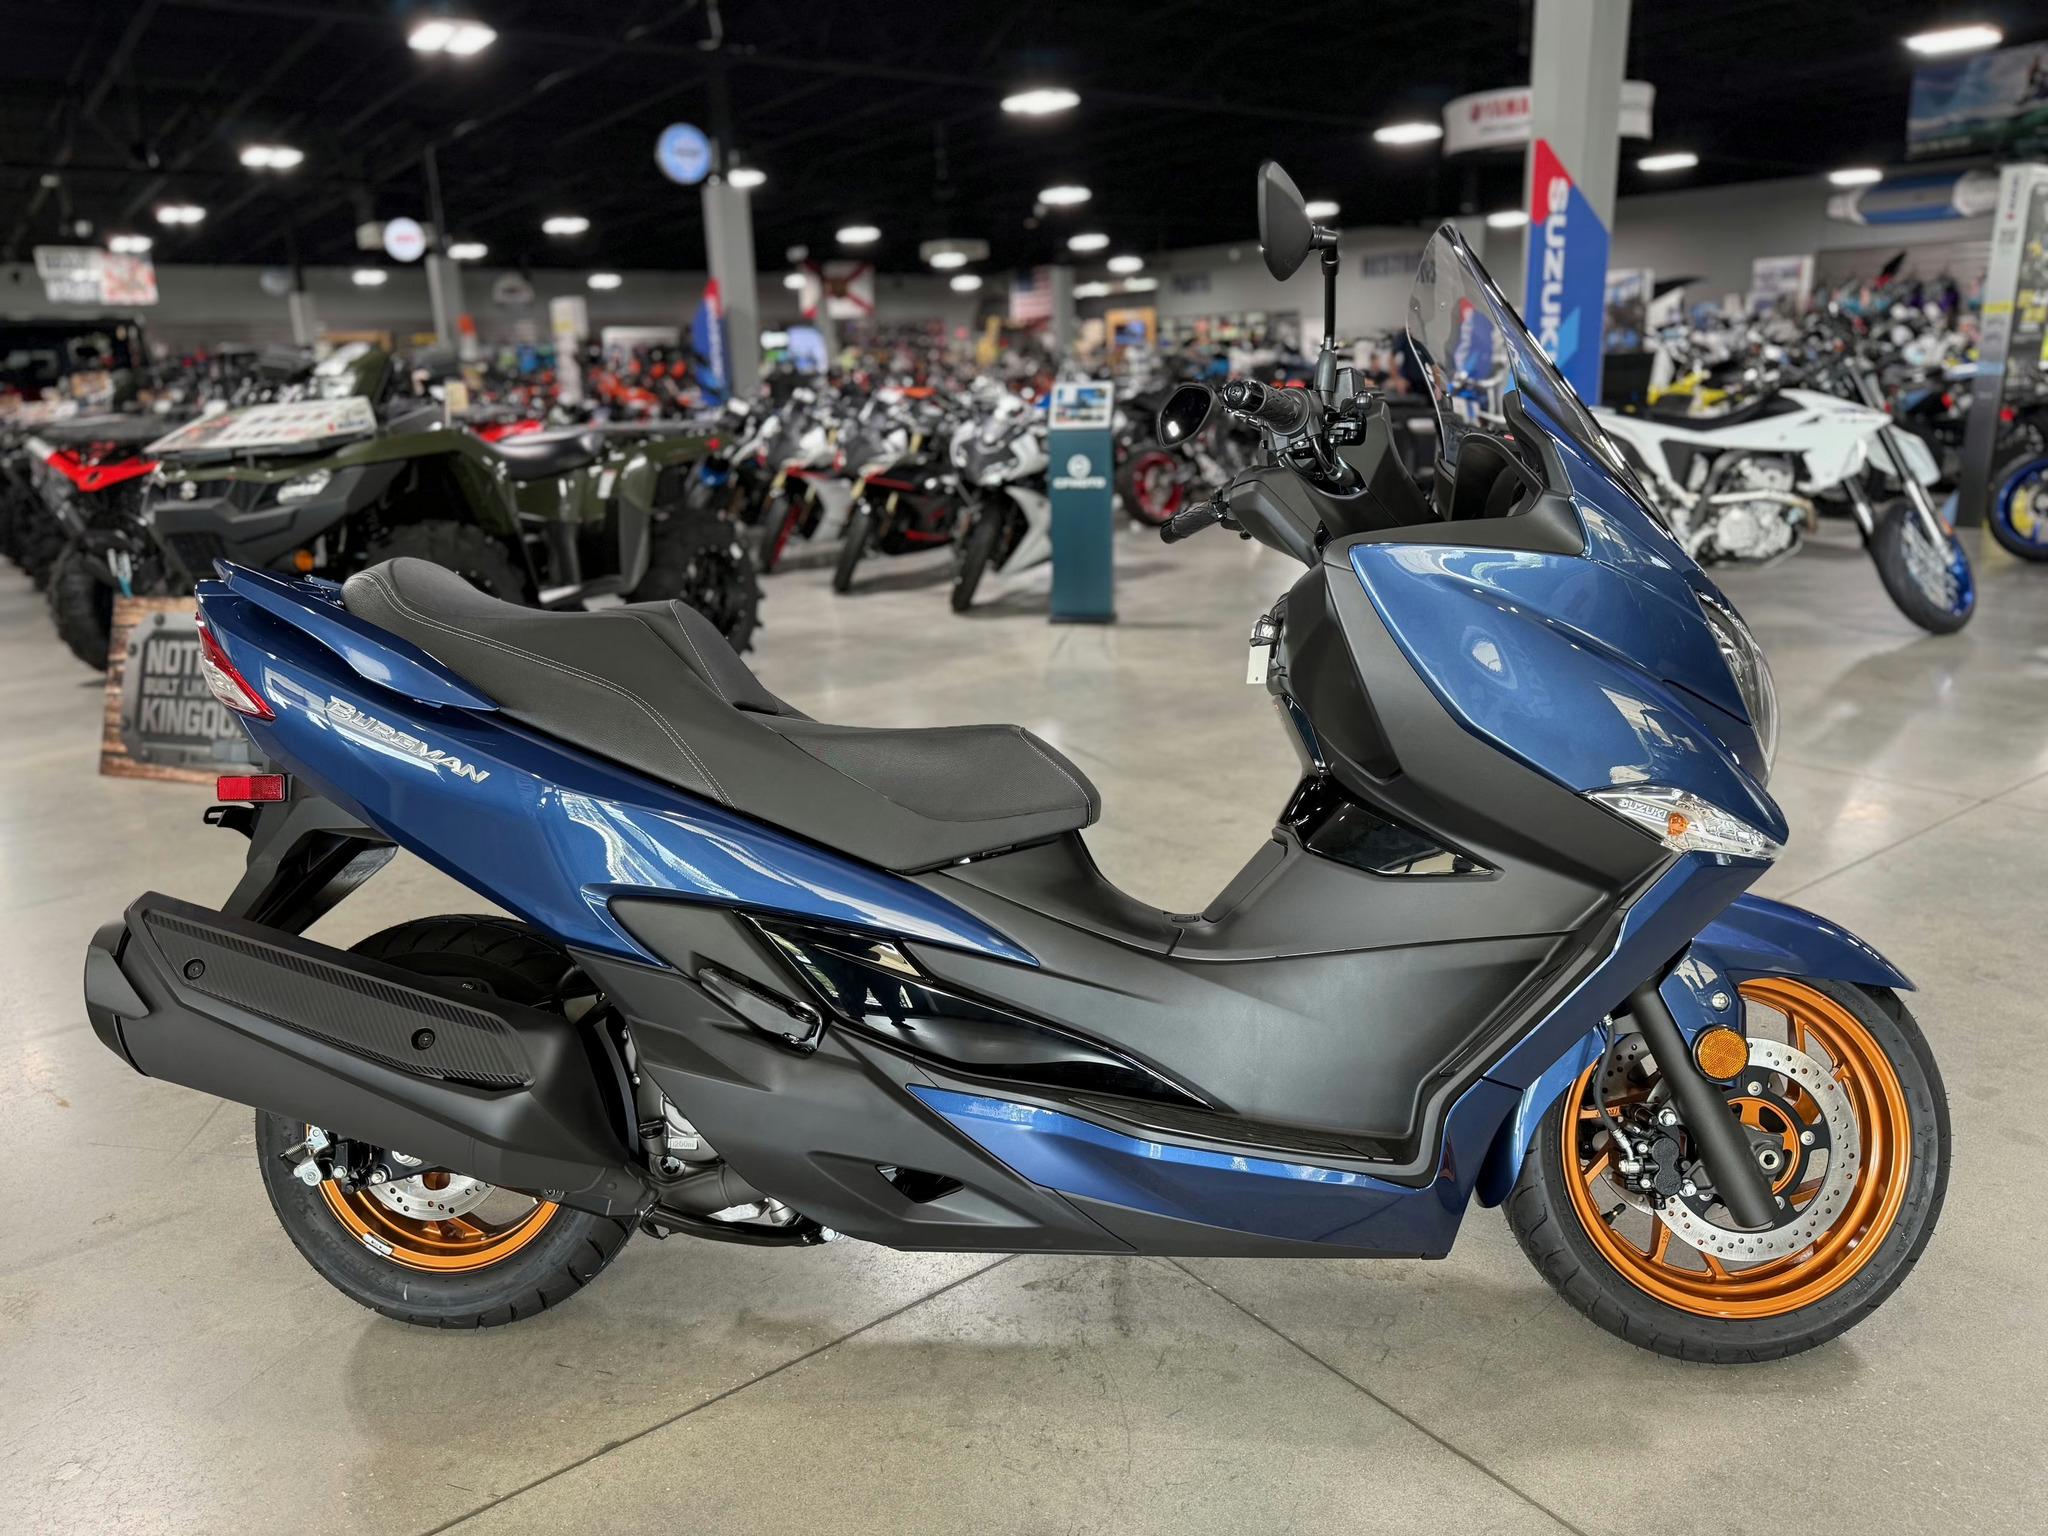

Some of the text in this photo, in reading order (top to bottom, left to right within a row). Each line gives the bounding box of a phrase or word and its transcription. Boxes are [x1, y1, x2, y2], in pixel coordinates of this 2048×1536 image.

[144, 640, 203, 676] NOT
[143, 677, 180, 696] BUILT
[140, 697, 241, 740] KINGQU
[324, 695, 490, 784] BURGMAN
[1619, 799, 1668, 819] SUZUKI
